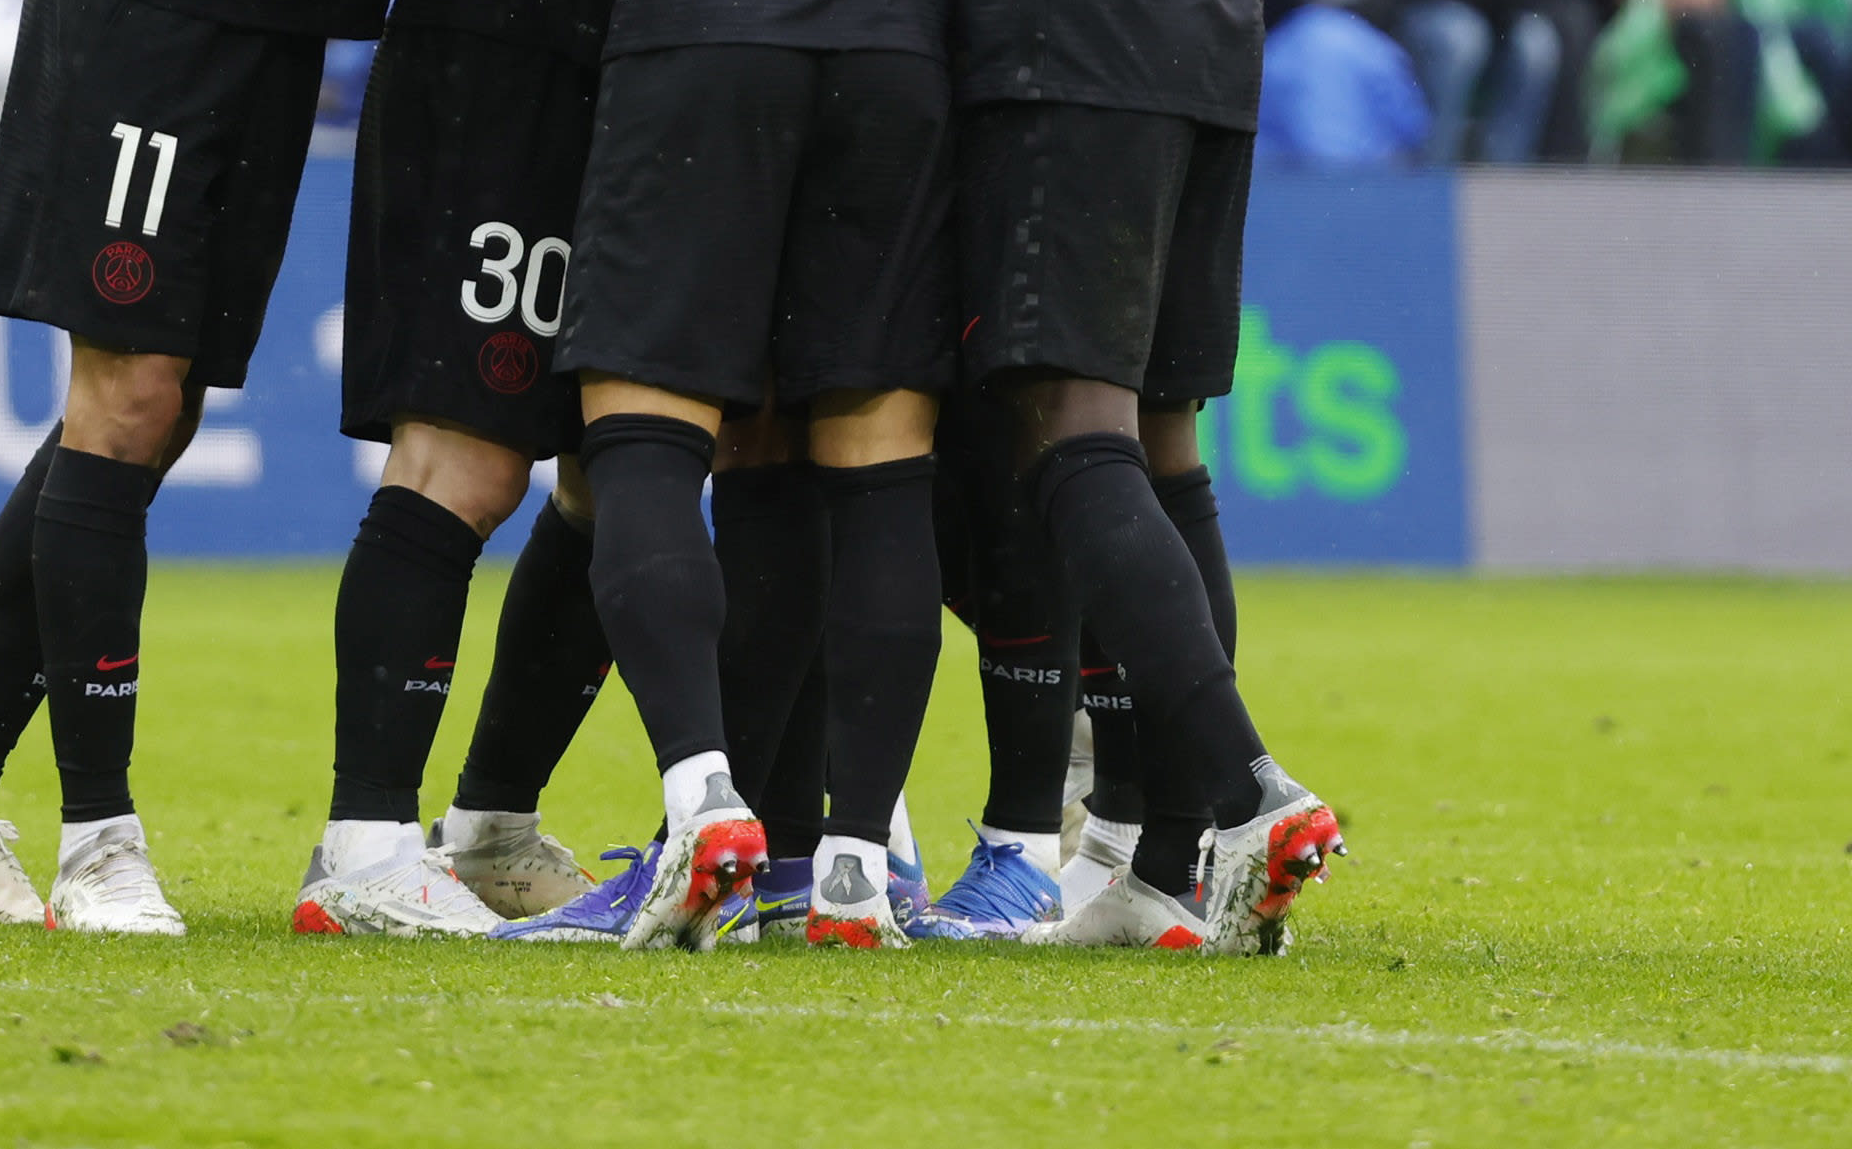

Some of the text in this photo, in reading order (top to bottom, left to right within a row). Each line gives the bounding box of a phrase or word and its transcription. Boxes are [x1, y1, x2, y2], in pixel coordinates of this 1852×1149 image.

[104, 121, 178, 237] 11
[460, 220, 573, 338] 30
[980, 656, 1062, 685] PARIS
